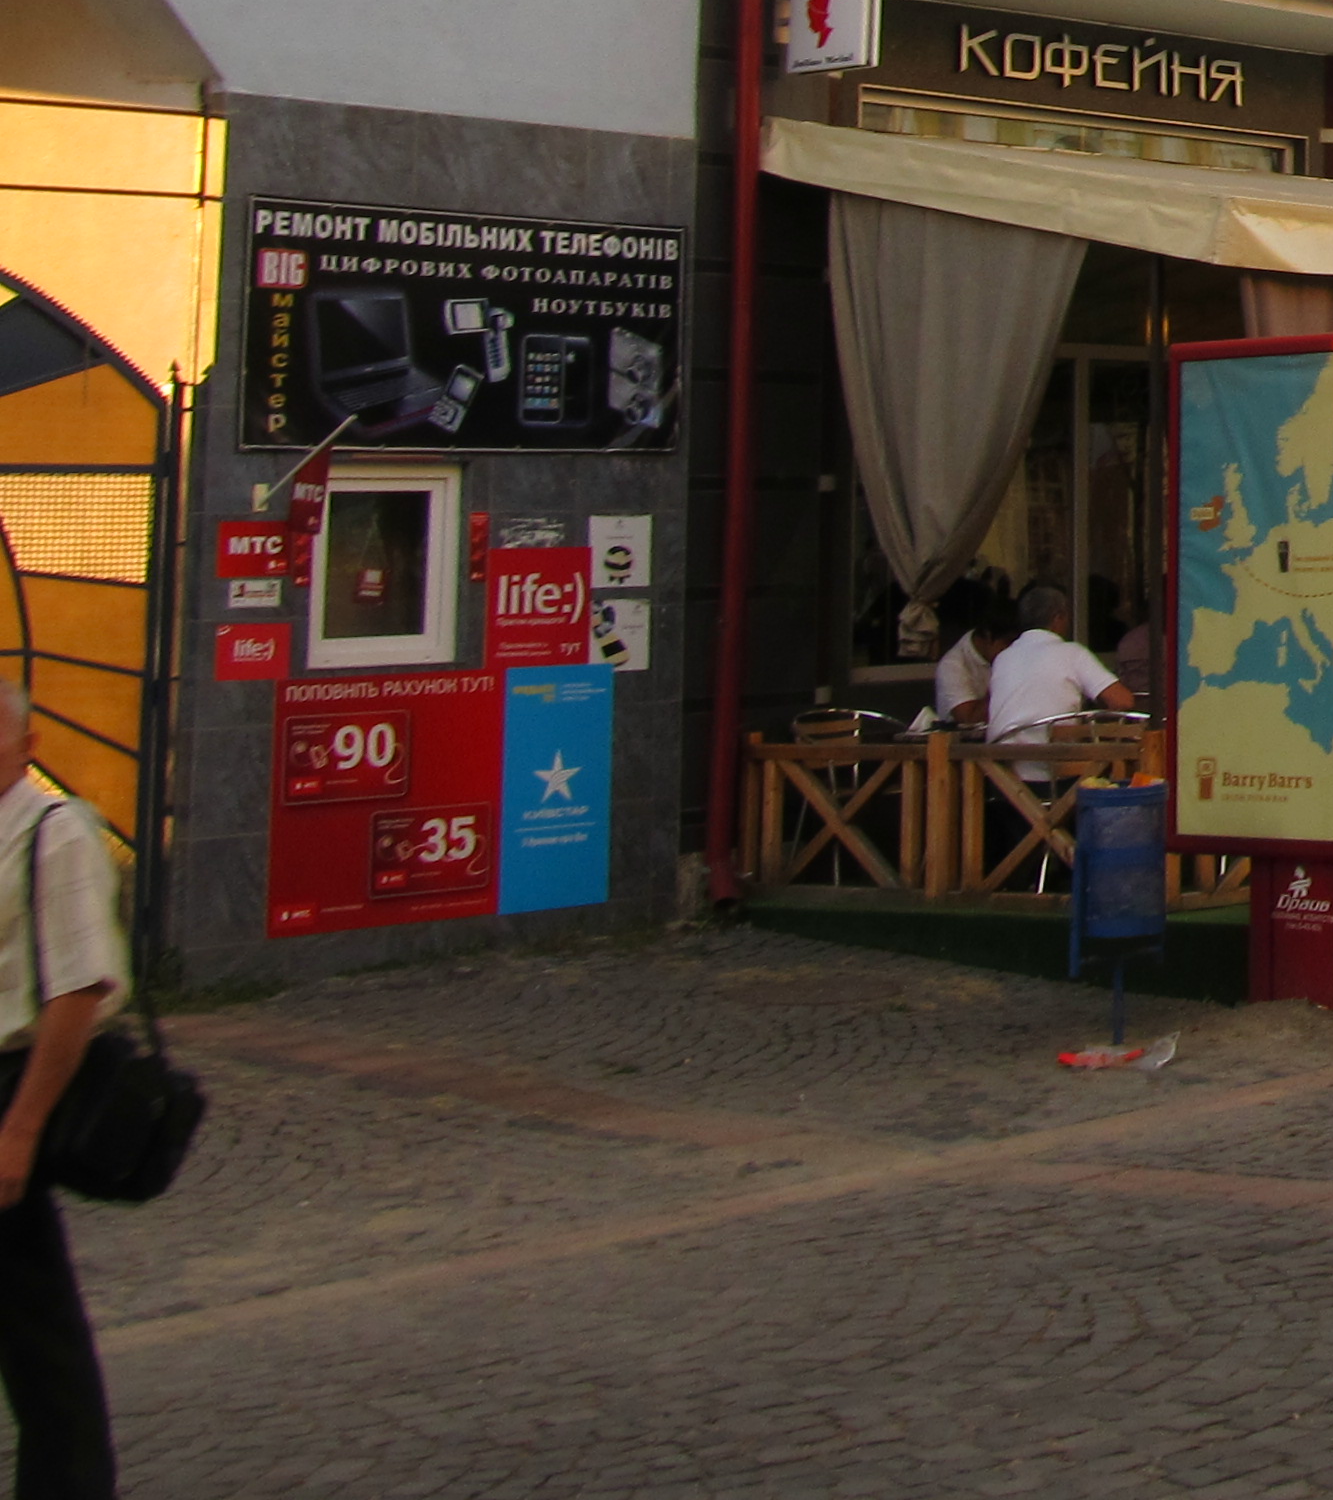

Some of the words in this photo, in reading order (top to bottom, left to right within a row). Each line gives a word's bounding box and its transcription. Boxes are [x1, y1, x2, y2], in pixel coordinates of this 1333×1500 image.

[959, 23, 1244, 107] КОФЕЙНЯ
[255, 209, 371, 241] РЕМОНТ
[376, 218, 533, 253] МОБІЛЬНИХ
[539, 230, 679, 261] ТЕЛЕФОНІВ
[262, 251, 306, 285] BIG
[319, 254, 473, 278] ЦИФРОВИХ
[481, 264, 673, 290] ФОТОАПАРАТІВ
[531, 297, 672, 318] НОУТБУКІВ
[267, 292, 294, 432] майстер
[294, 483, 325, 502] МТС
[228, 536, 284, 555] МТС
[496, 572, 585, 624] life:)
[382, 677, 458, 697] РАХУНОК
[333, 723, 397, 770] 90
[1222, 772, 1266, 791] Barry
[419, 815, 477, 862] 35
